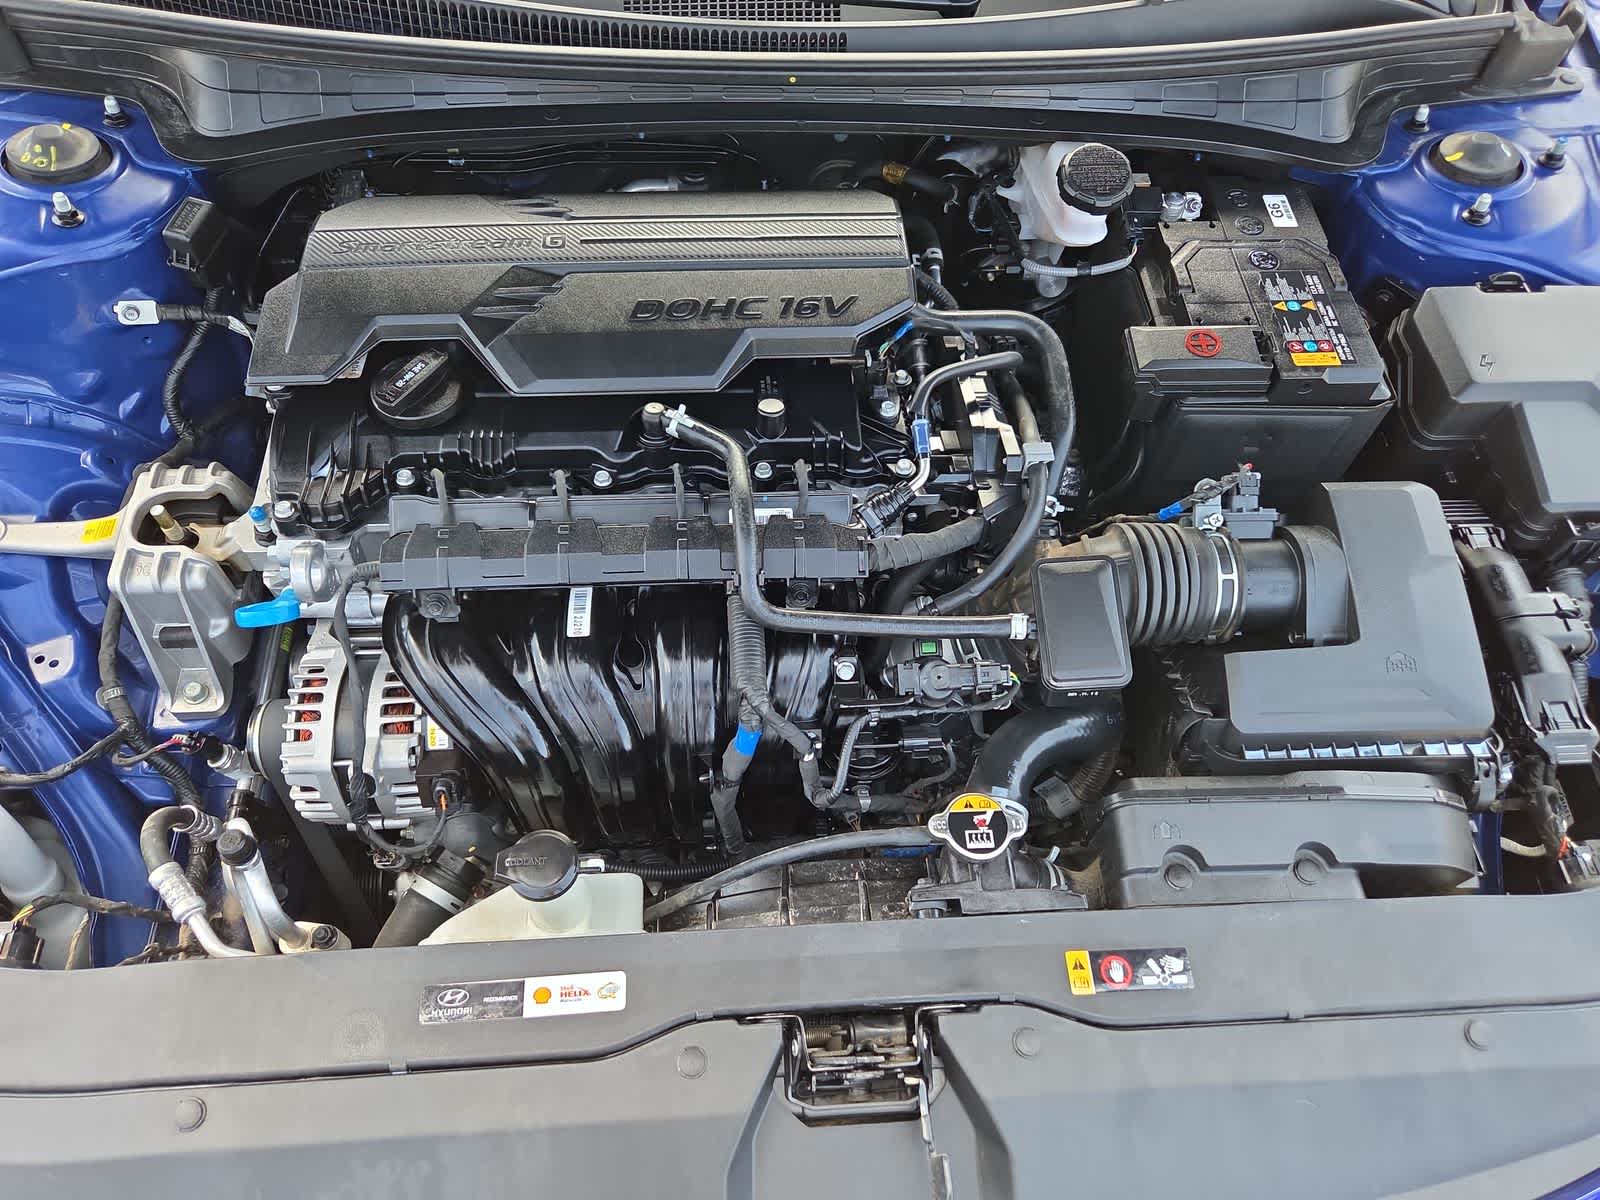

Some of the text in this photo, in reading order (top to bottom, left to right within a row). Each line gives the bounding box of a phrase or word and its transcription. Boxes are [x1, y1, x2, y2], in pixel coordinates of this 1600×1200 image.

[1268, 203, 1284, 218] G6
[333, 234, 565, 255] Smartstream G
[629, 294, 859, 321] DOHC 16V
[411, 361, 426, 373] SAE
[560, 988, 590, 998] HELIX
[431, 1007, 472, 1017] HYUNDAI
